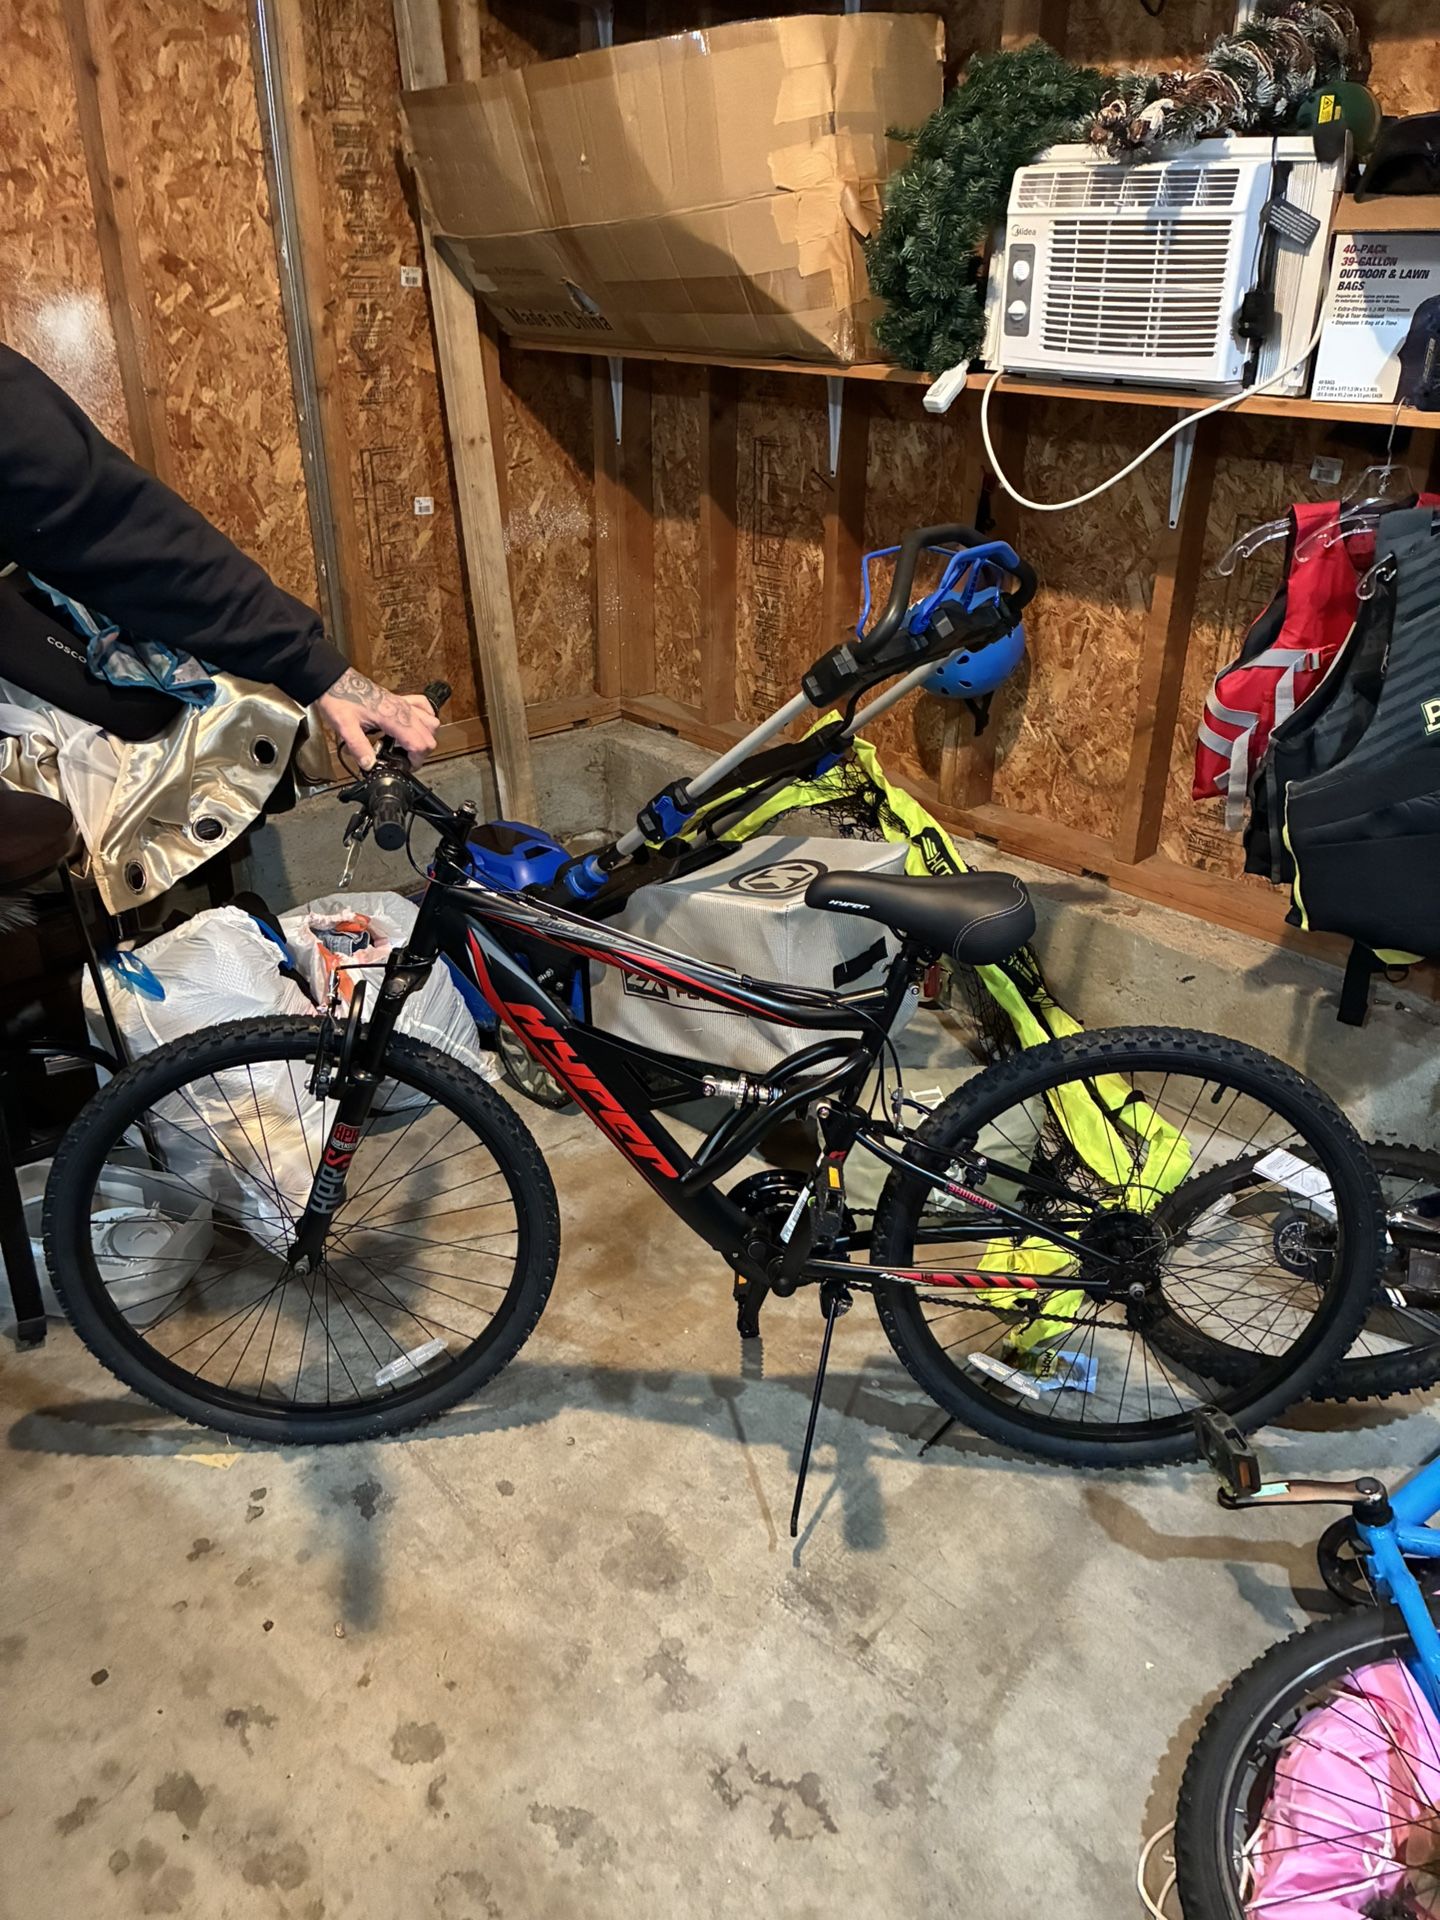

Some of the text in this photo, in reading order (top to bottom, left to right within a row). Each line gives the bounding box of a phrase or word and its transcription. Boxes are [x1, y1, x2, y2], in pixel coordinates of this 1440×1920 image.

[1015, 226, 1037, 236] Midea
[1343, 244, 1388, 254] 40-PACK
[1341, 256, 1399, 267] 39-GALLON
[1339, 269, 1431, 280] OUTDOOR & LAWN
[1337, 281, 1366, 291] BAGS
[505, 306, 552, 328] Made
[563, 310, 614, 331] China
[47, 636, 87, 663] COSCO
[947, 1182, 997, 1211] SHIMANO
